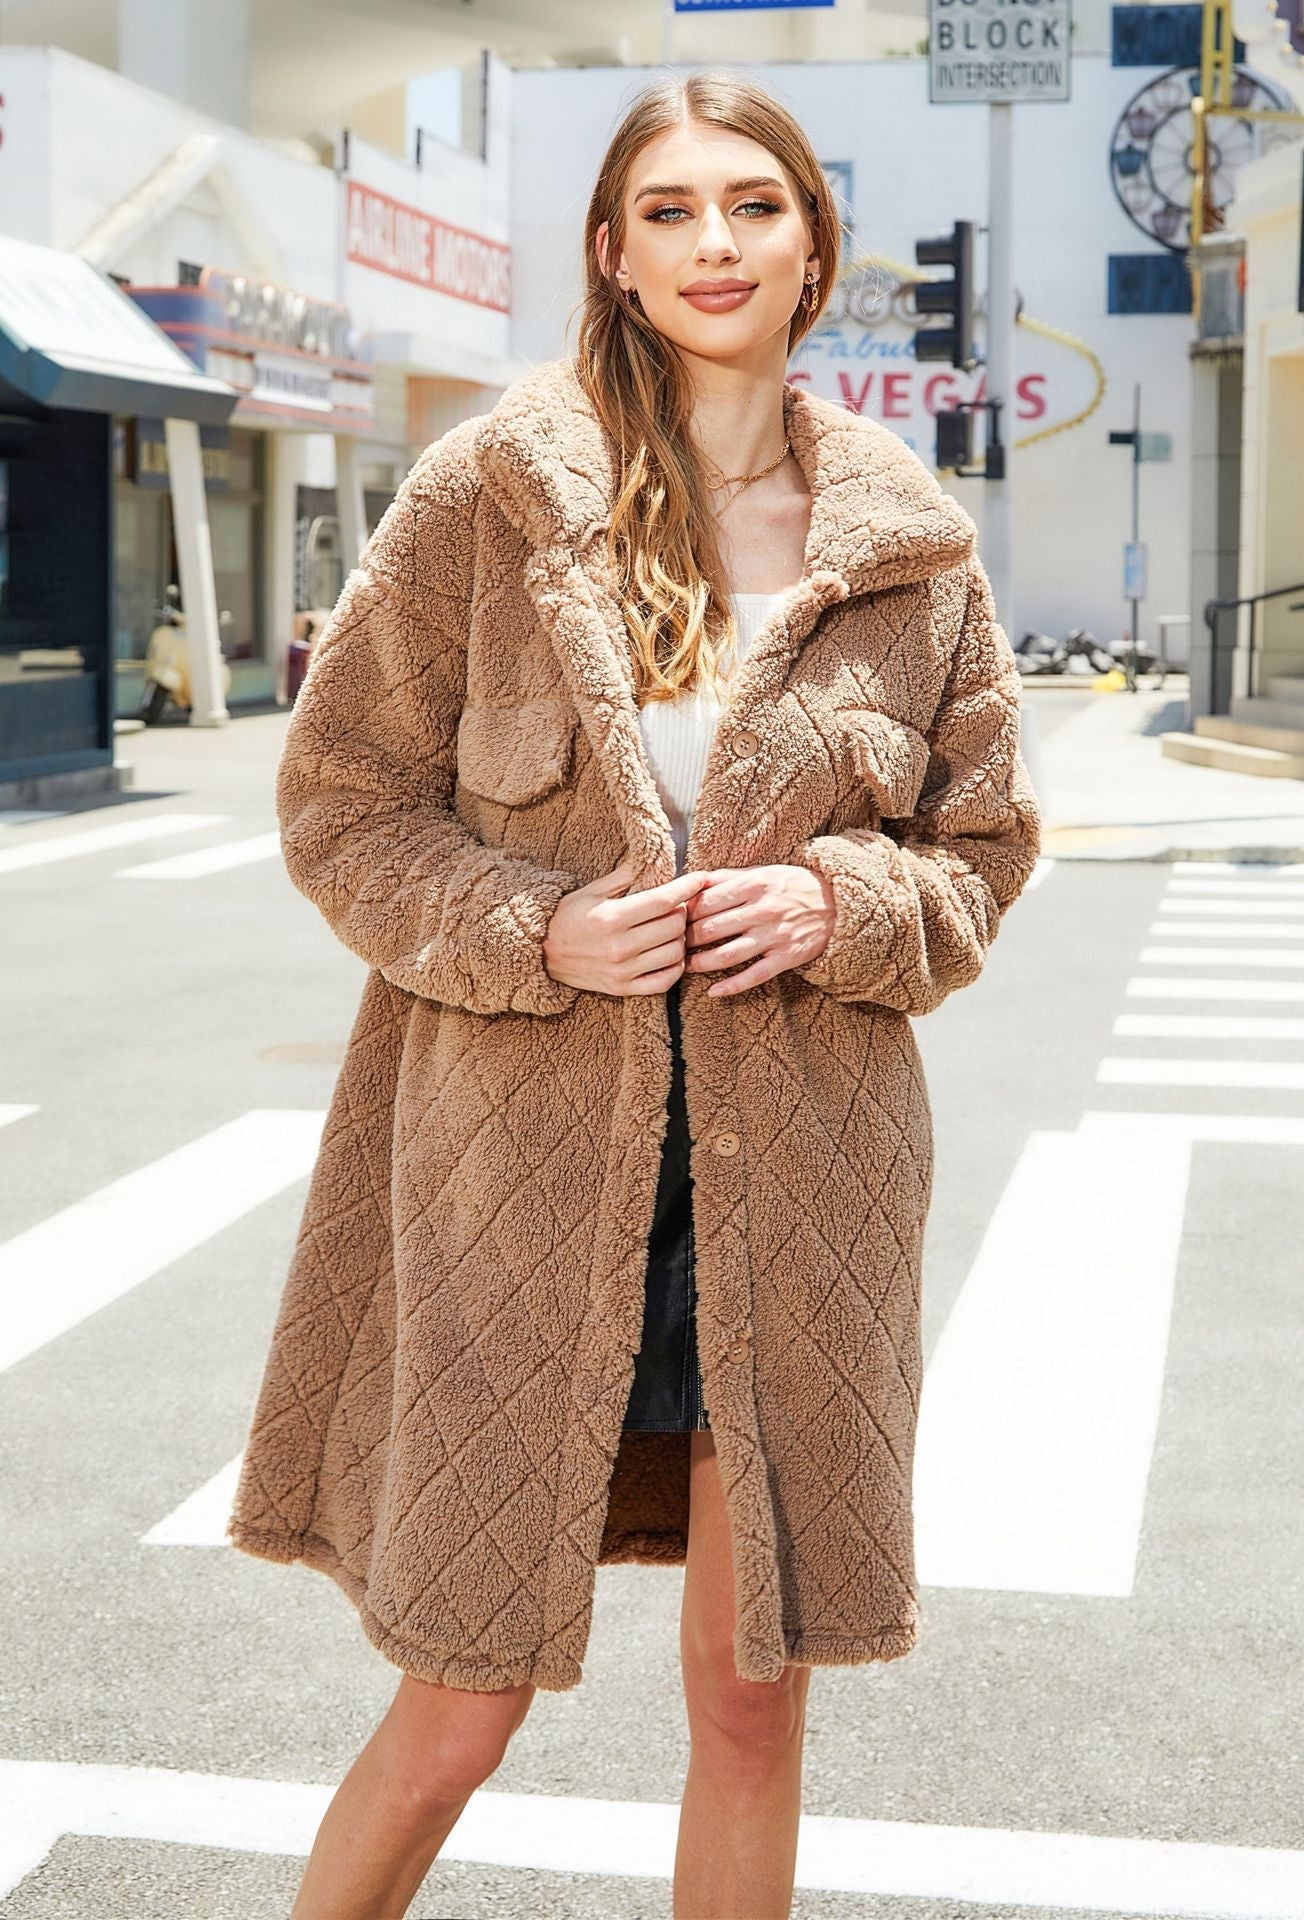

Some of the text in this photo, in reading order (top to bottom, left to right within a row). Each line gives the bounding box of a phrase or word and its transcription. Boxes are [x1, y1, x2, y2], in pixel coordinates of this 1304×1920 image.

[938, 20, 1059, 50] BLOCK
[939, 61, 1060, 88] INTERSECTION
[348, 189, 511, 310] AIRLINE MOTORS
